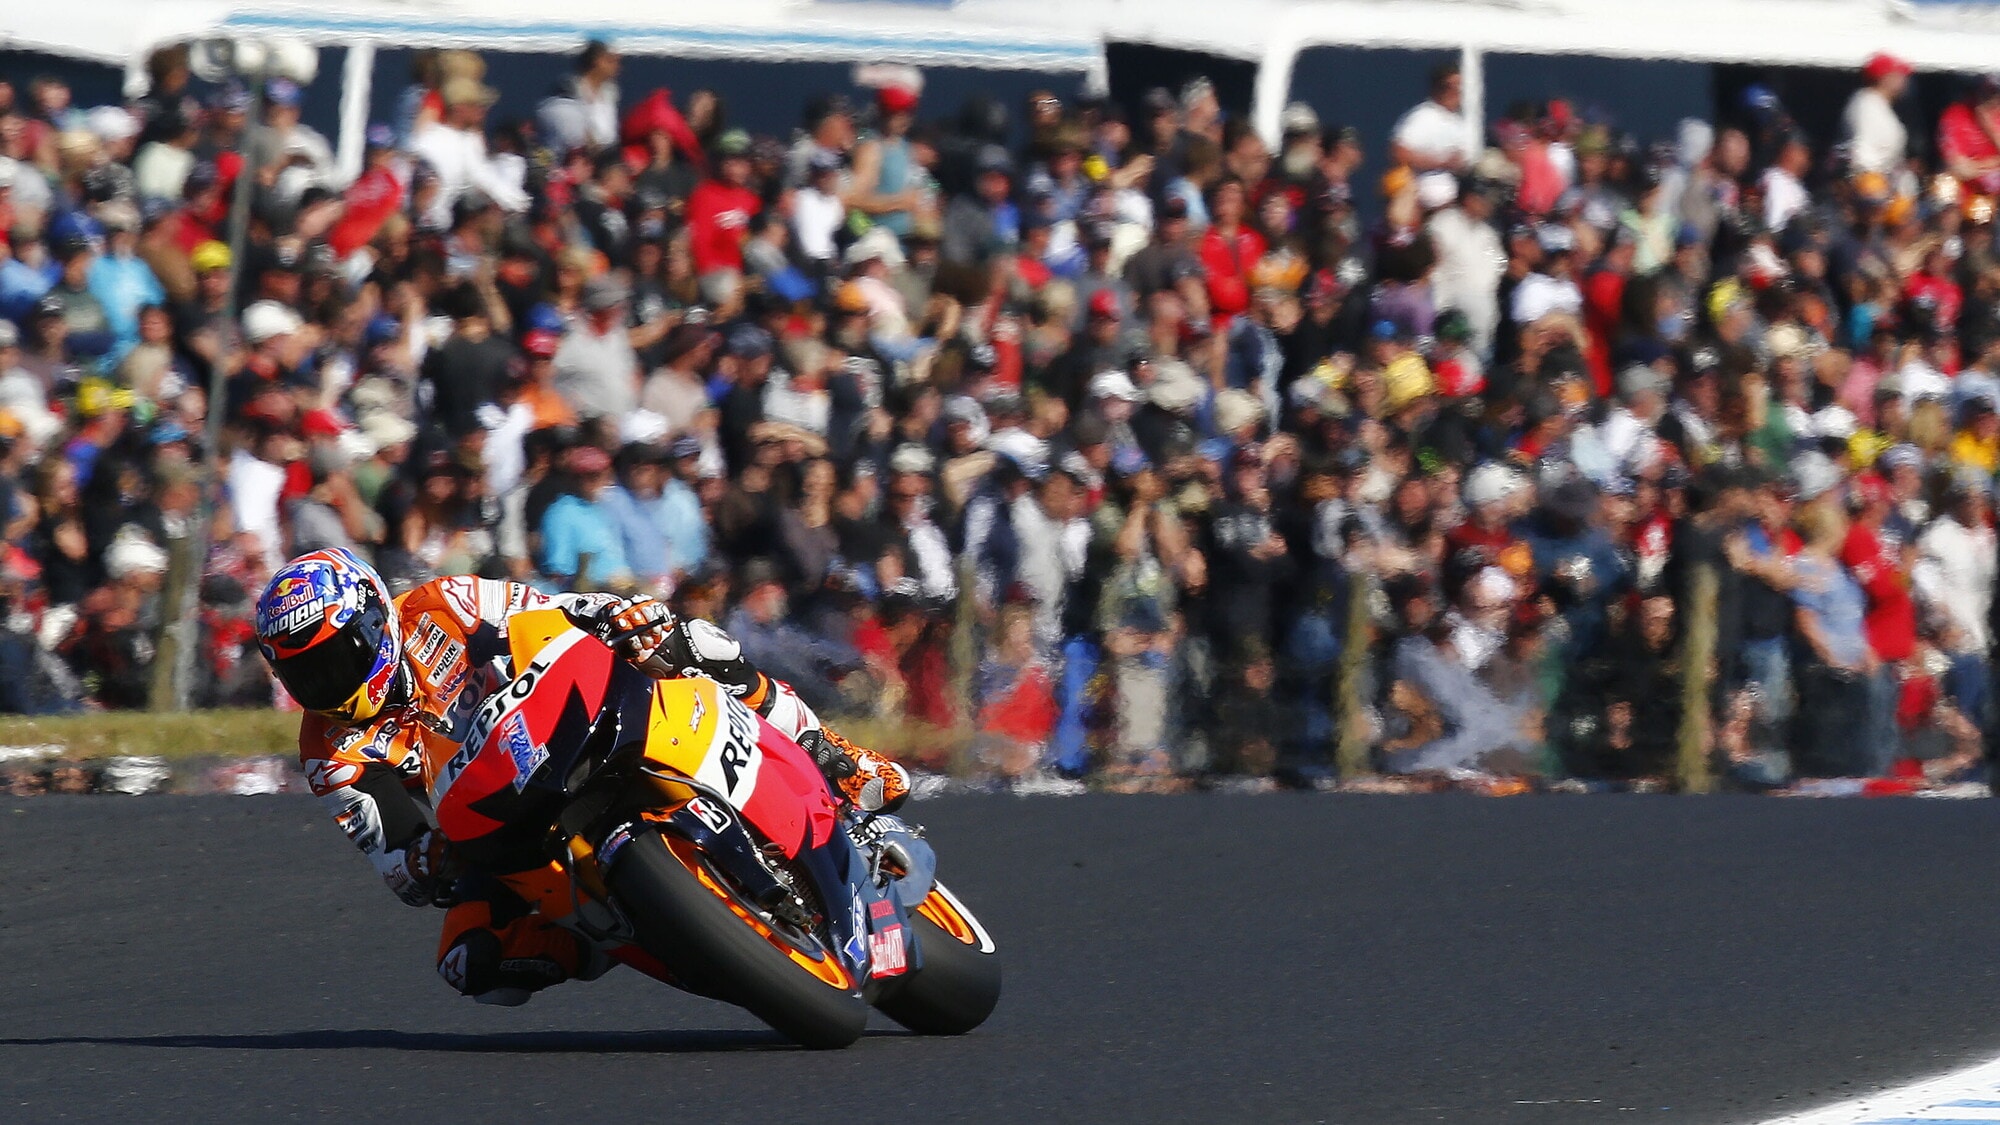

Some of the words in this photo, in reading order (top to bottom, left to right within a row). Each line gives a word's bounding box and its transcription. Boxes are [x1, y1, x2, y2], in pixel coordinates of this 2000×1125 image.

[262, 597, 324, 637] NOLAN
[267, 598, 288, 620] Red
[287, 582, 316, 610] Bull
[418, 629, 442, 661] REPSOL
[432, 643, 457, 681] NOLAN
[374, 721, 399, 754] GAS
[447, 660, 551, 782] REPSOL
